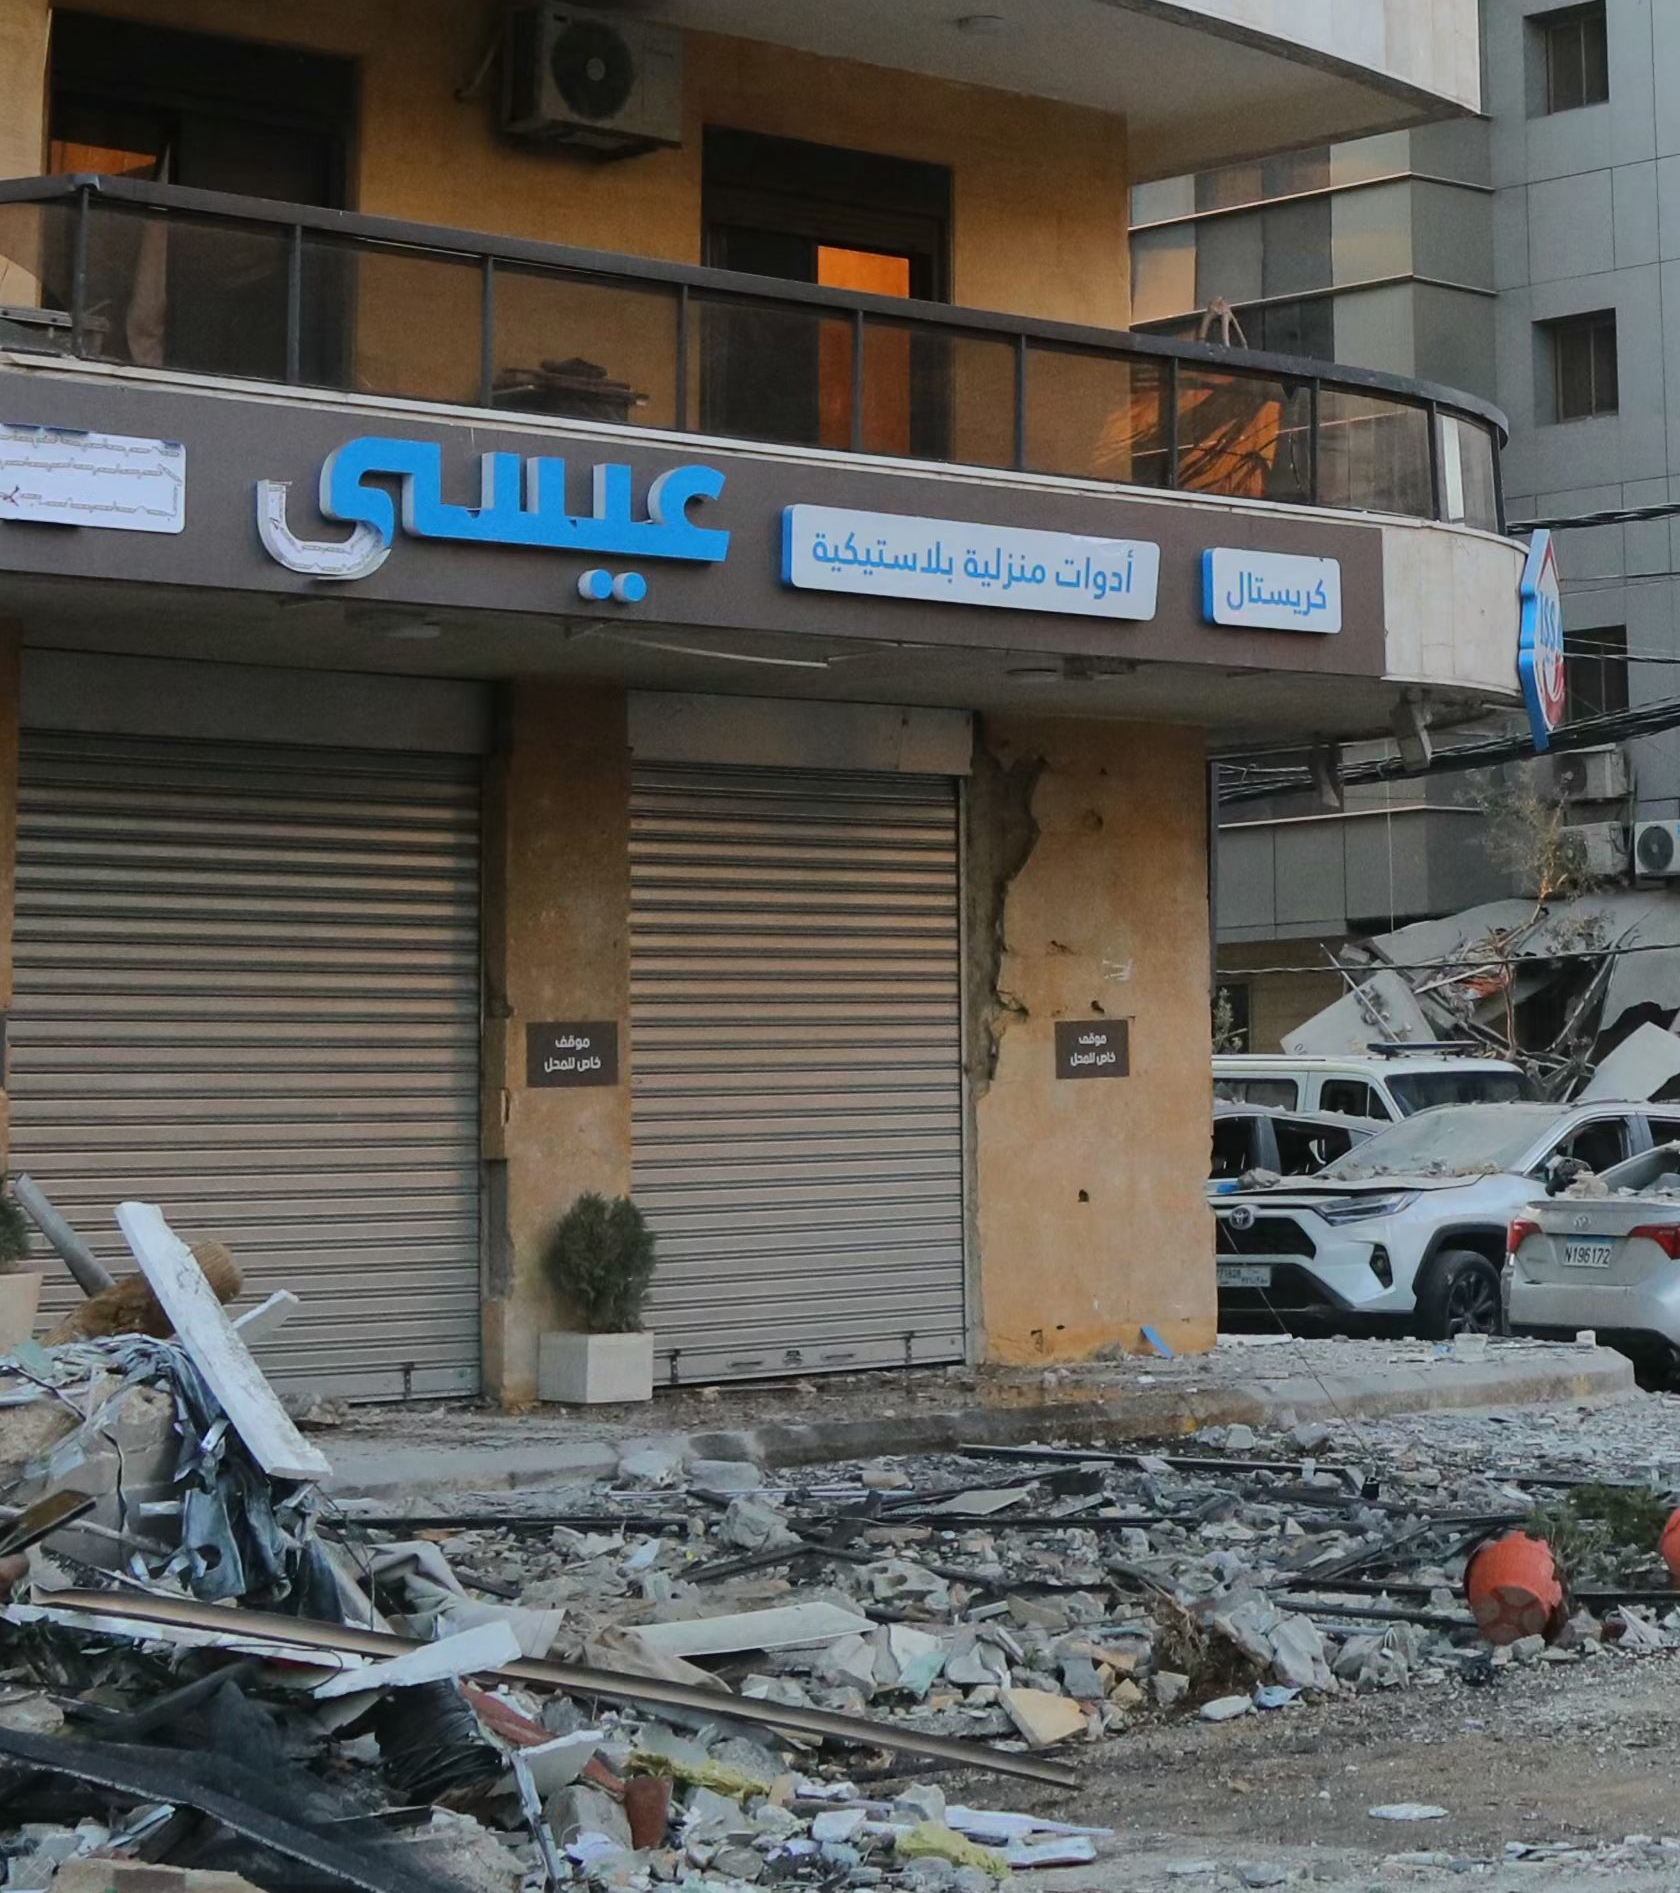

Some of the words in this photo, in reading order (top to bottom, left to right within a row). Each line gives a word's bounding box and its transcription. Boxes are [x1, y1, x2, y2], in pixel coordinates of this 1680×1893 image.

[257, 435, 731, 603] عيسى
[812, 532, 953, 584] بلاستيكية
[963, 547, 1046, 590] منزلية
[1055, 548, 1135, 600] أدوات
[1226, 570, 1327, 616] كريستال
[555, 1034, 590, 1050] موقف
[1078, 1032, 1107, 1047] موقف
[544, 1057, 575, 1073] للمحل
[577, 1056, 601, 1072] خاص
[1070, 1052, 1095, 1067] للمحل
[1096, 1051, 1116, 1066] خاص
